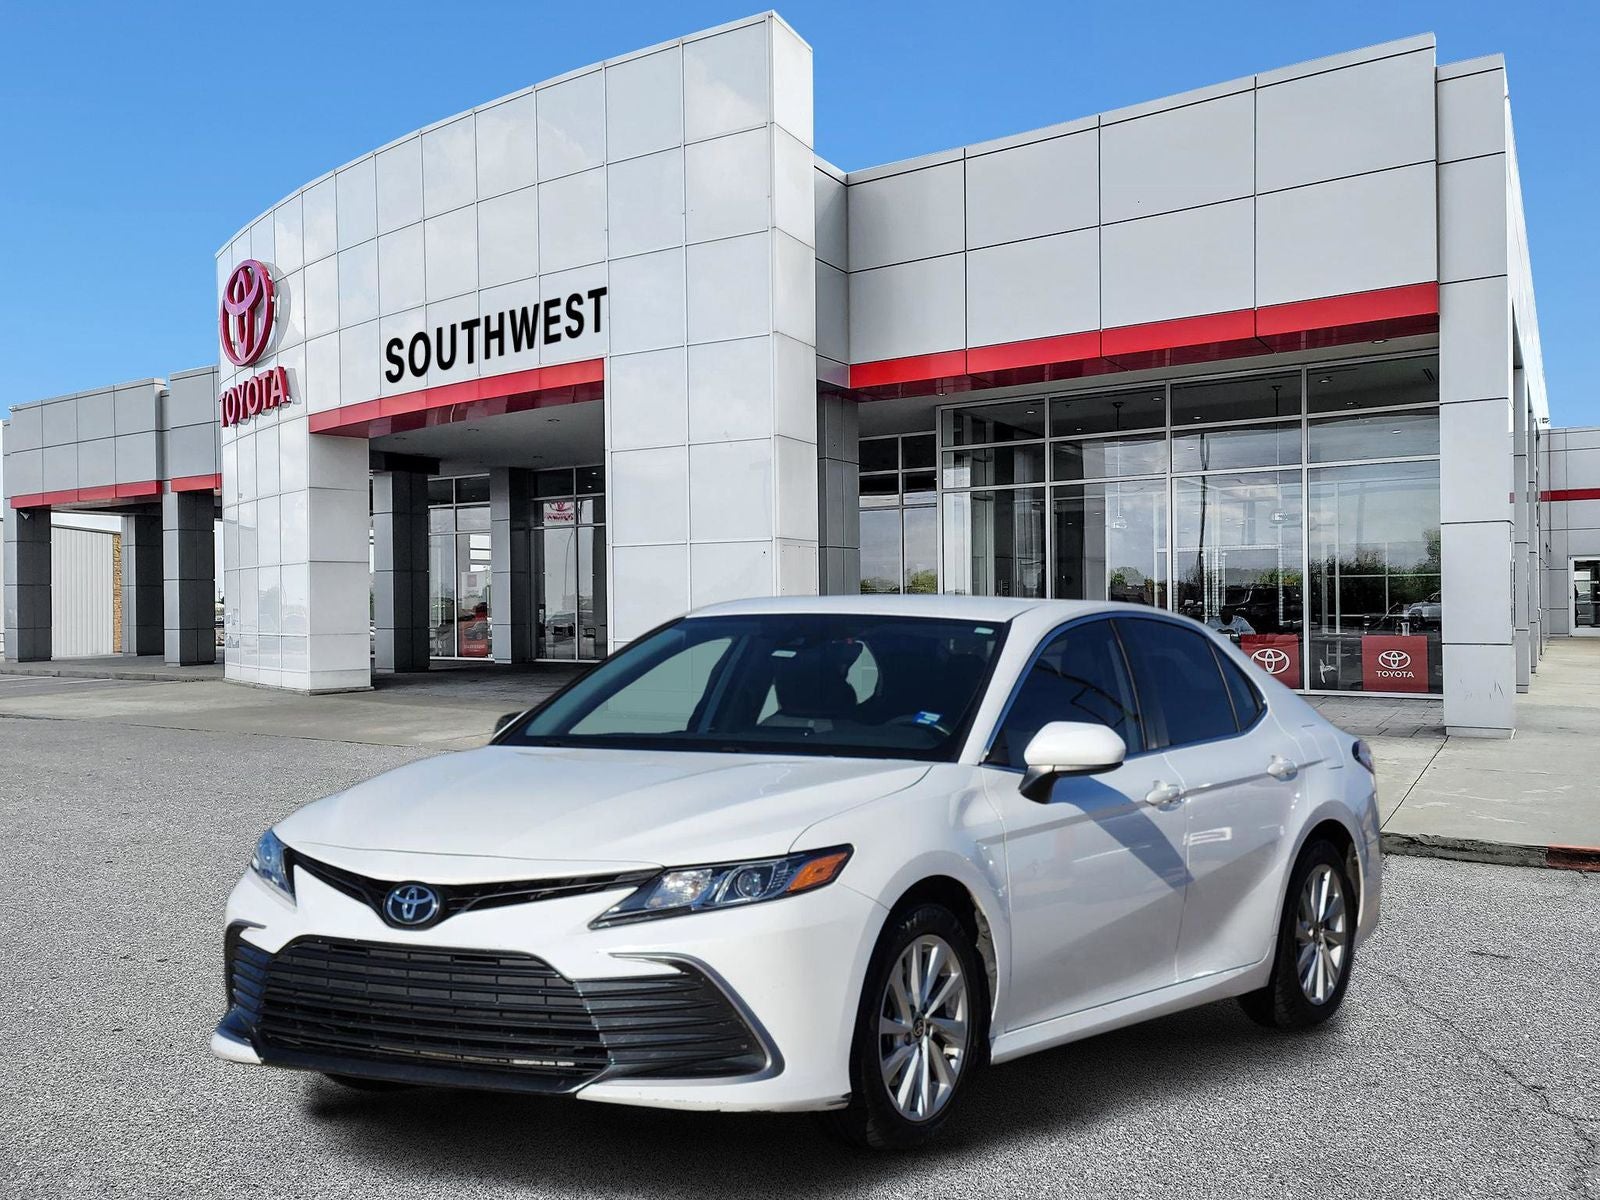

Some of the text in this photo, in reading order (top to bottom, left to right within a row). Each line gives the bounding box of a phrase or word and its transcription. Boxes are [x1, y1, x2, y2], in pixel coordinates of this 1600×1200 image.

[385, 286, 607, 383] SOUTHWEST
[218, 366, 290, 428] TOYOTA
[1375, 670, 1415, 678] TOYOTA
